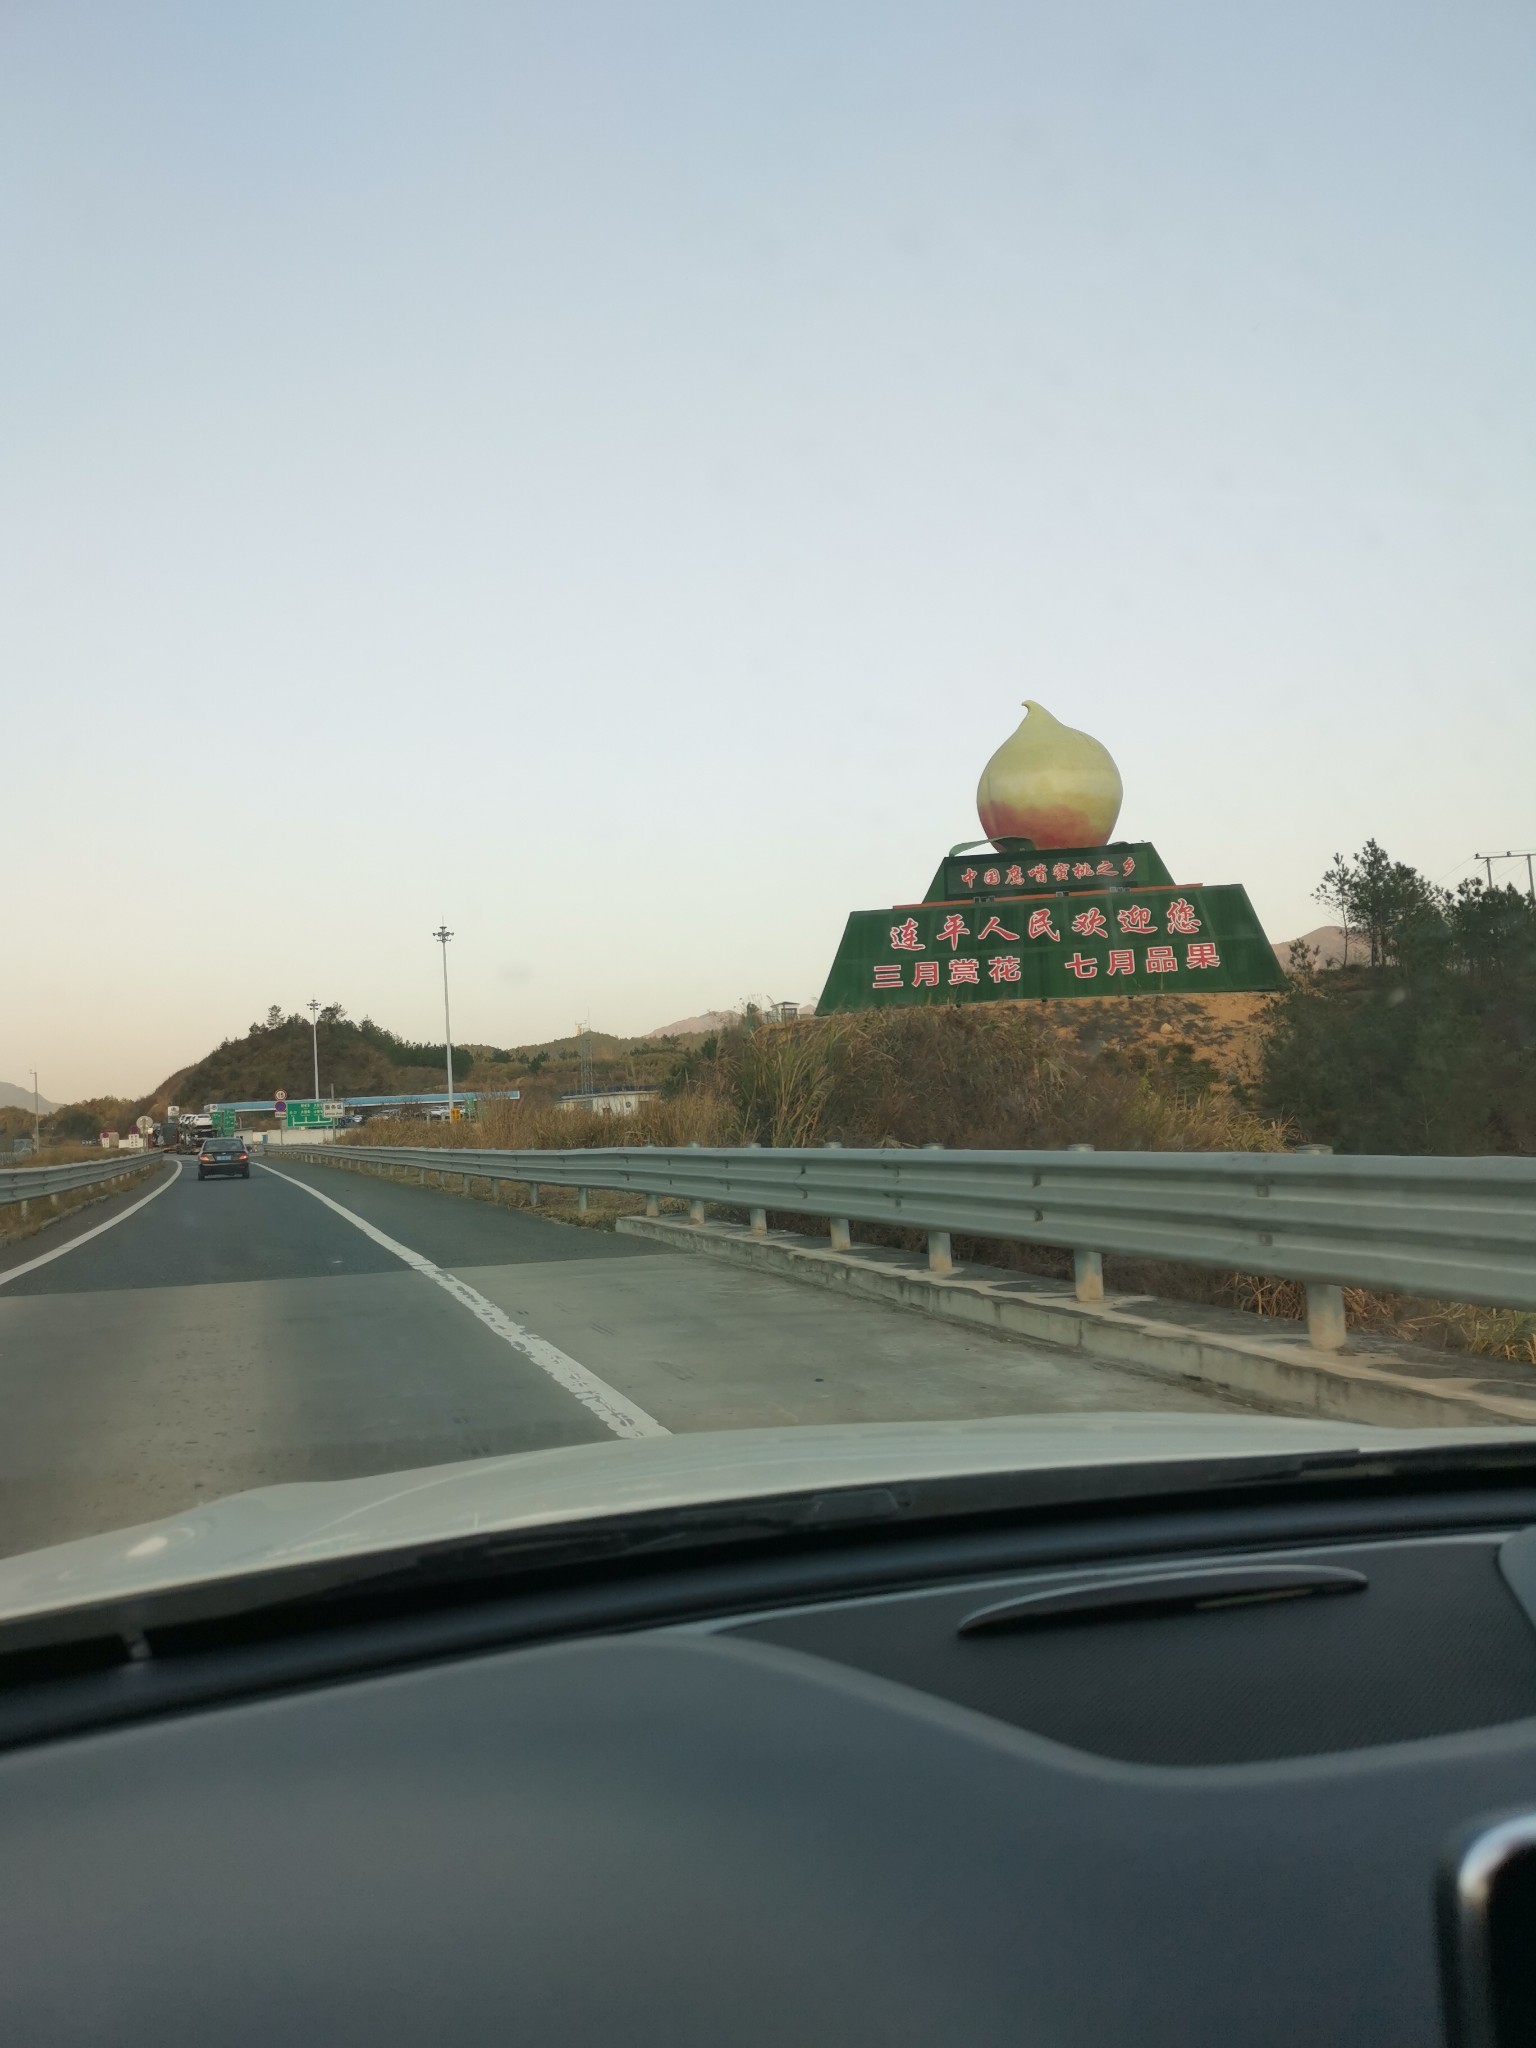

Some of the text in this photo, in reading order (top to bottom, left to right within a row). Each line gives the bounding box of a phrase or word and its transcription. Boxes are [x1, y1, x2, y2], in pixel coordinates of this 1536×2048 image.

[960, 856, 1137, 889] 中国鹰嘴蜜桃之乡
[890, 898, 1202, 951] 连平人民欢迎您
[872, 942, 1221, 989] 三月赏花 七月品果
